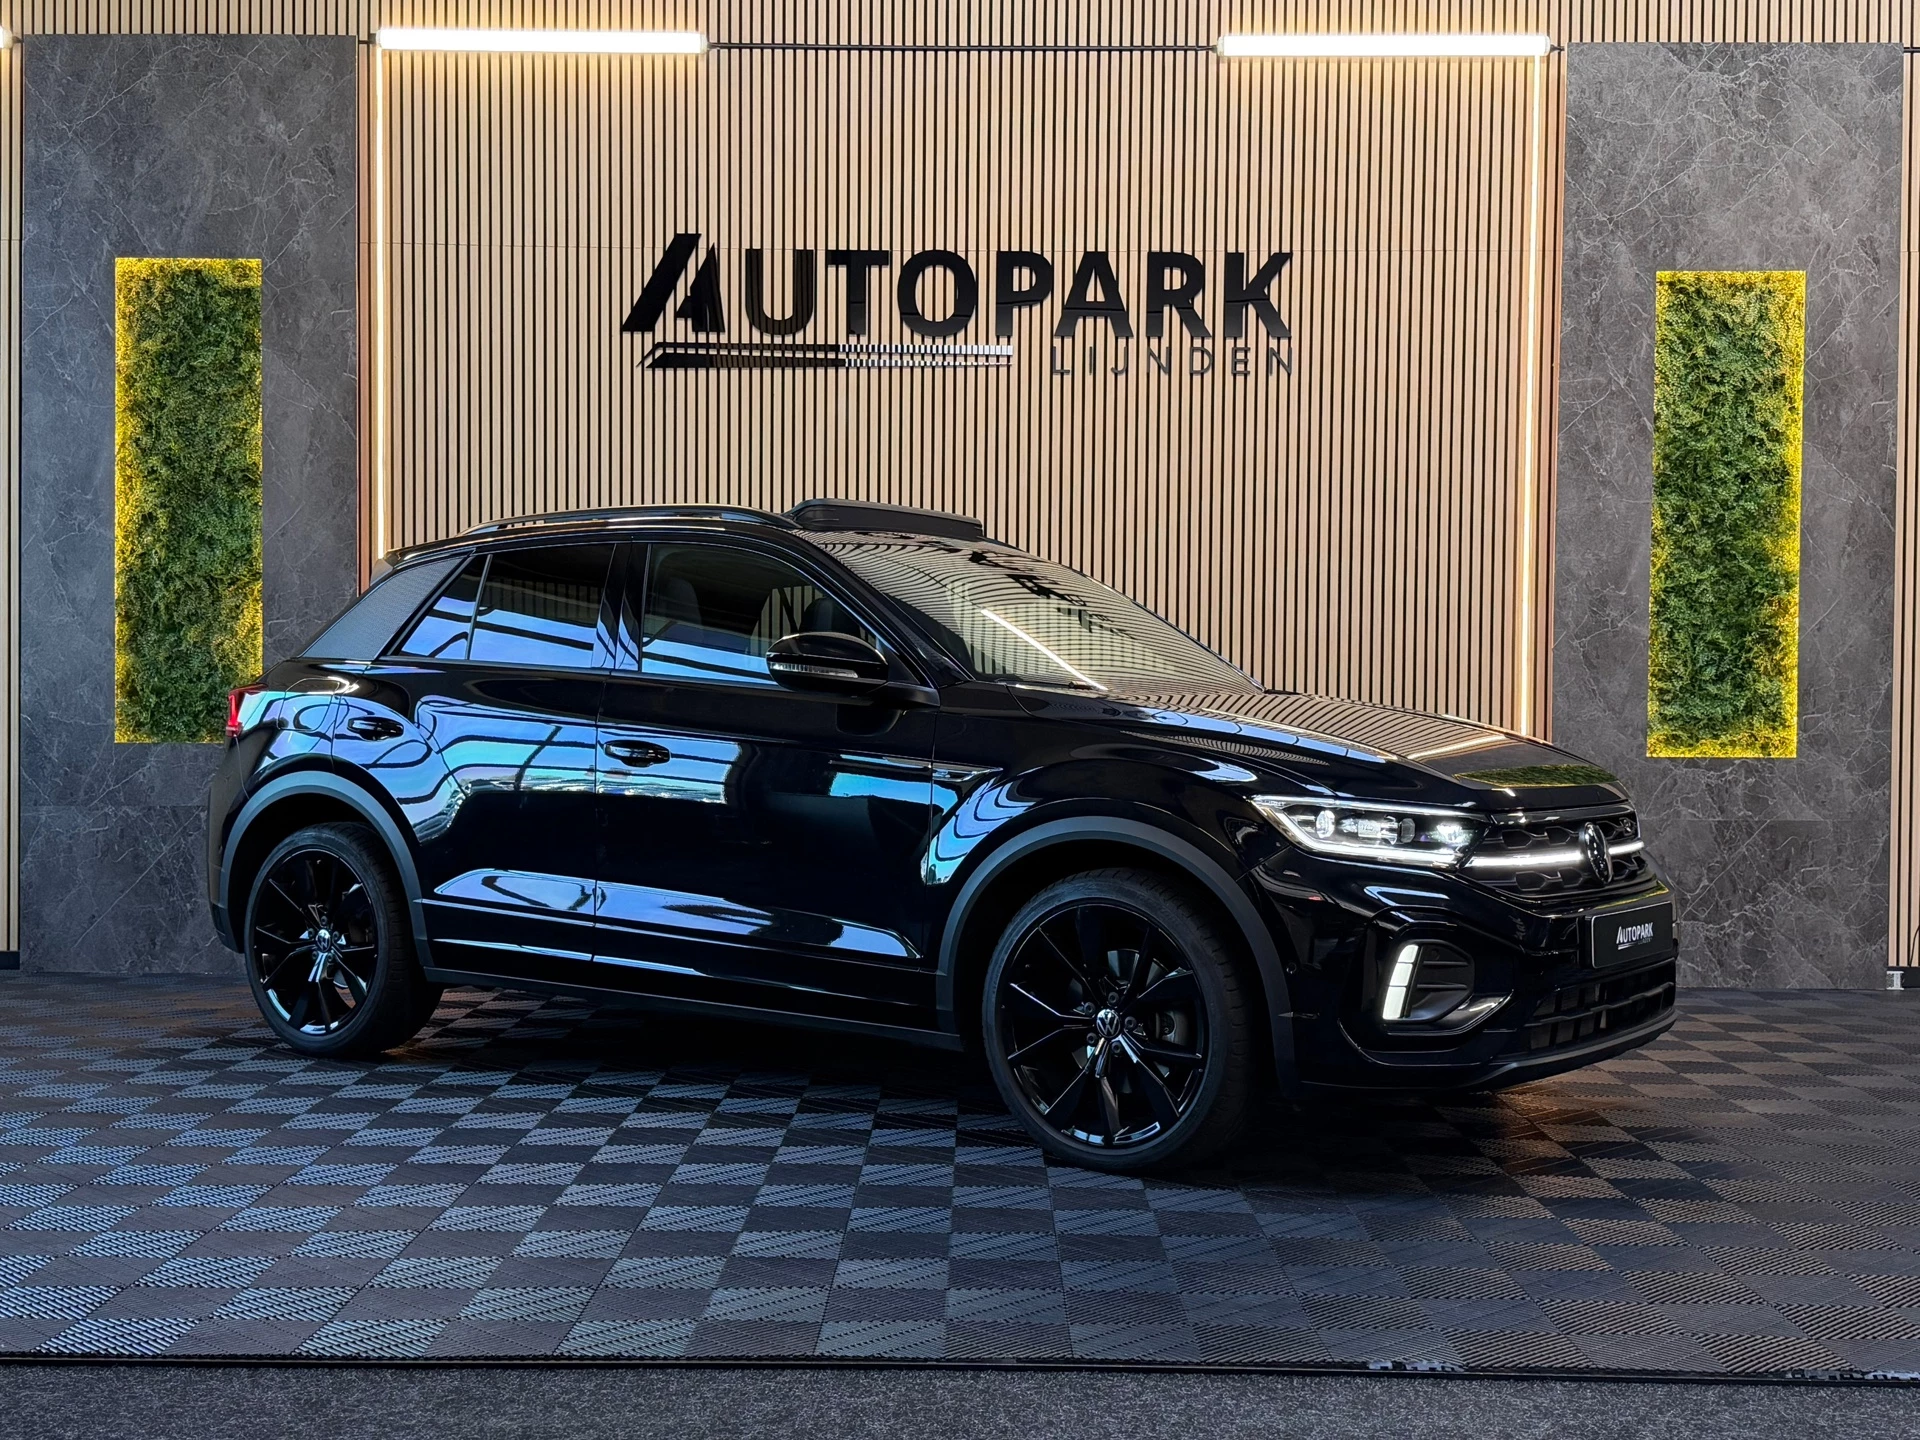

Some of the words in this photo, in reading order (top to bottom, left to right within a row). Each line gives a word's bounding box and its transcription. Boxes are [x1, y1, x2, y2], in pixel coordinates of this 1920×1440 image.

[621, 232, 1293, 338] AUTOPARK
[1051, 346, 1293, 376] LIJNDEN
[1616, 922, 1654, 945] AUTOPARK
